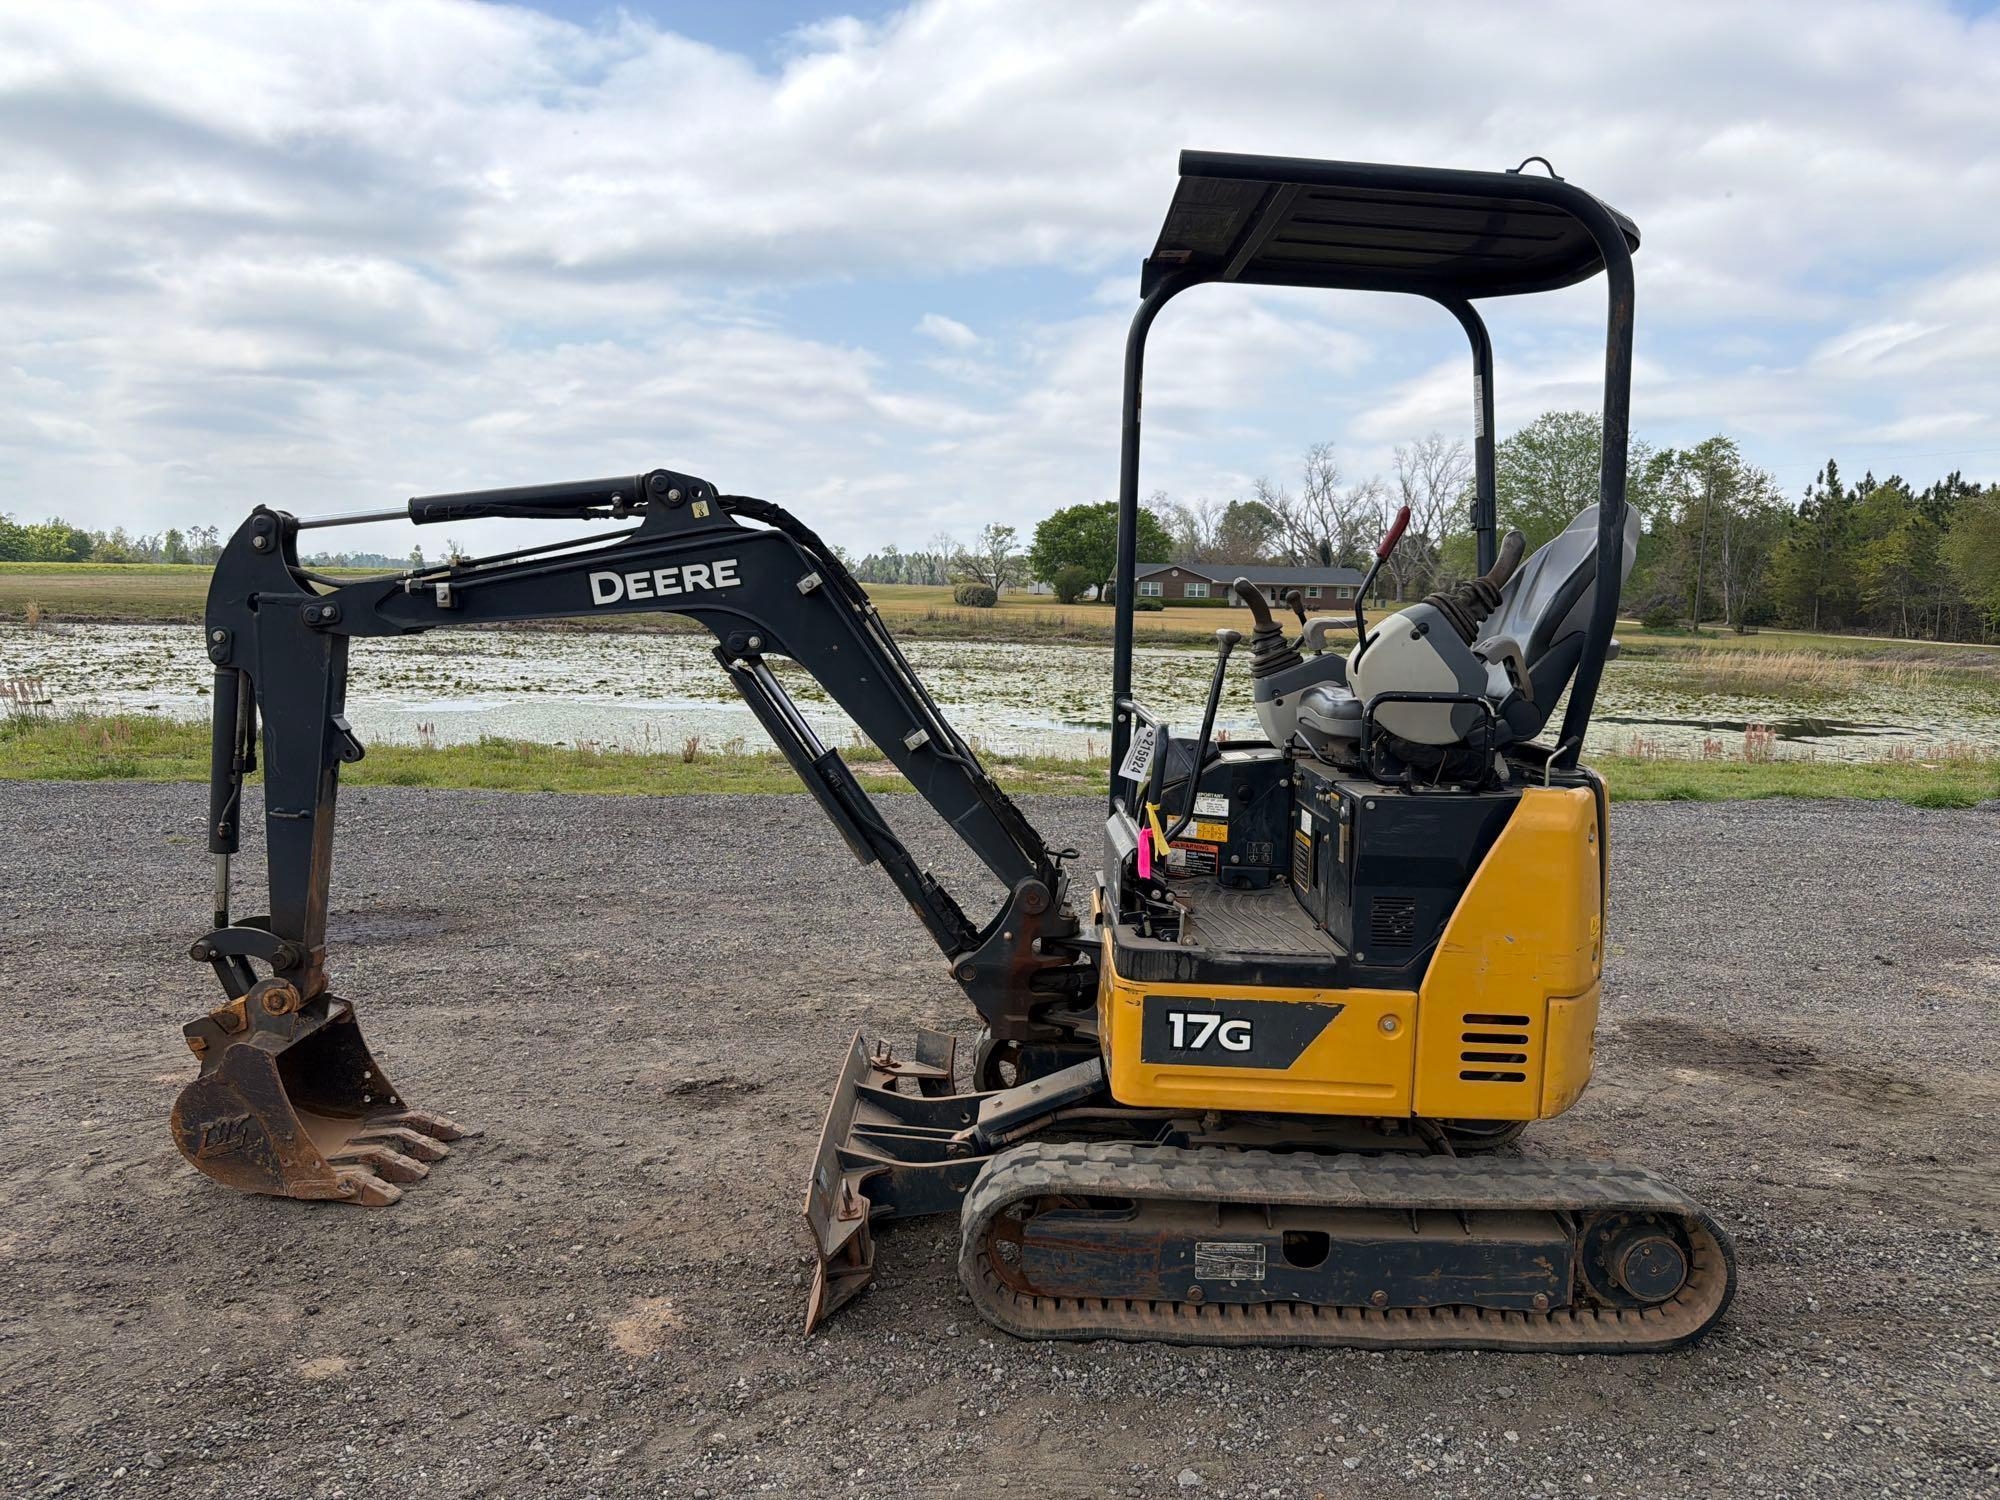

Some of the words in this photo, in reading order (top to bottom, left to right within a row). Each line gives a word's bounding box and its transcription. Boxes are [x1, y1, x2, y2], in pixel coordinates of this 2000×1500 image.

[589, 558, 741, 605] DEERE
[1130, 738, 1154, 774] 215924
[1168, 1012, 1251, 1051] 17G
